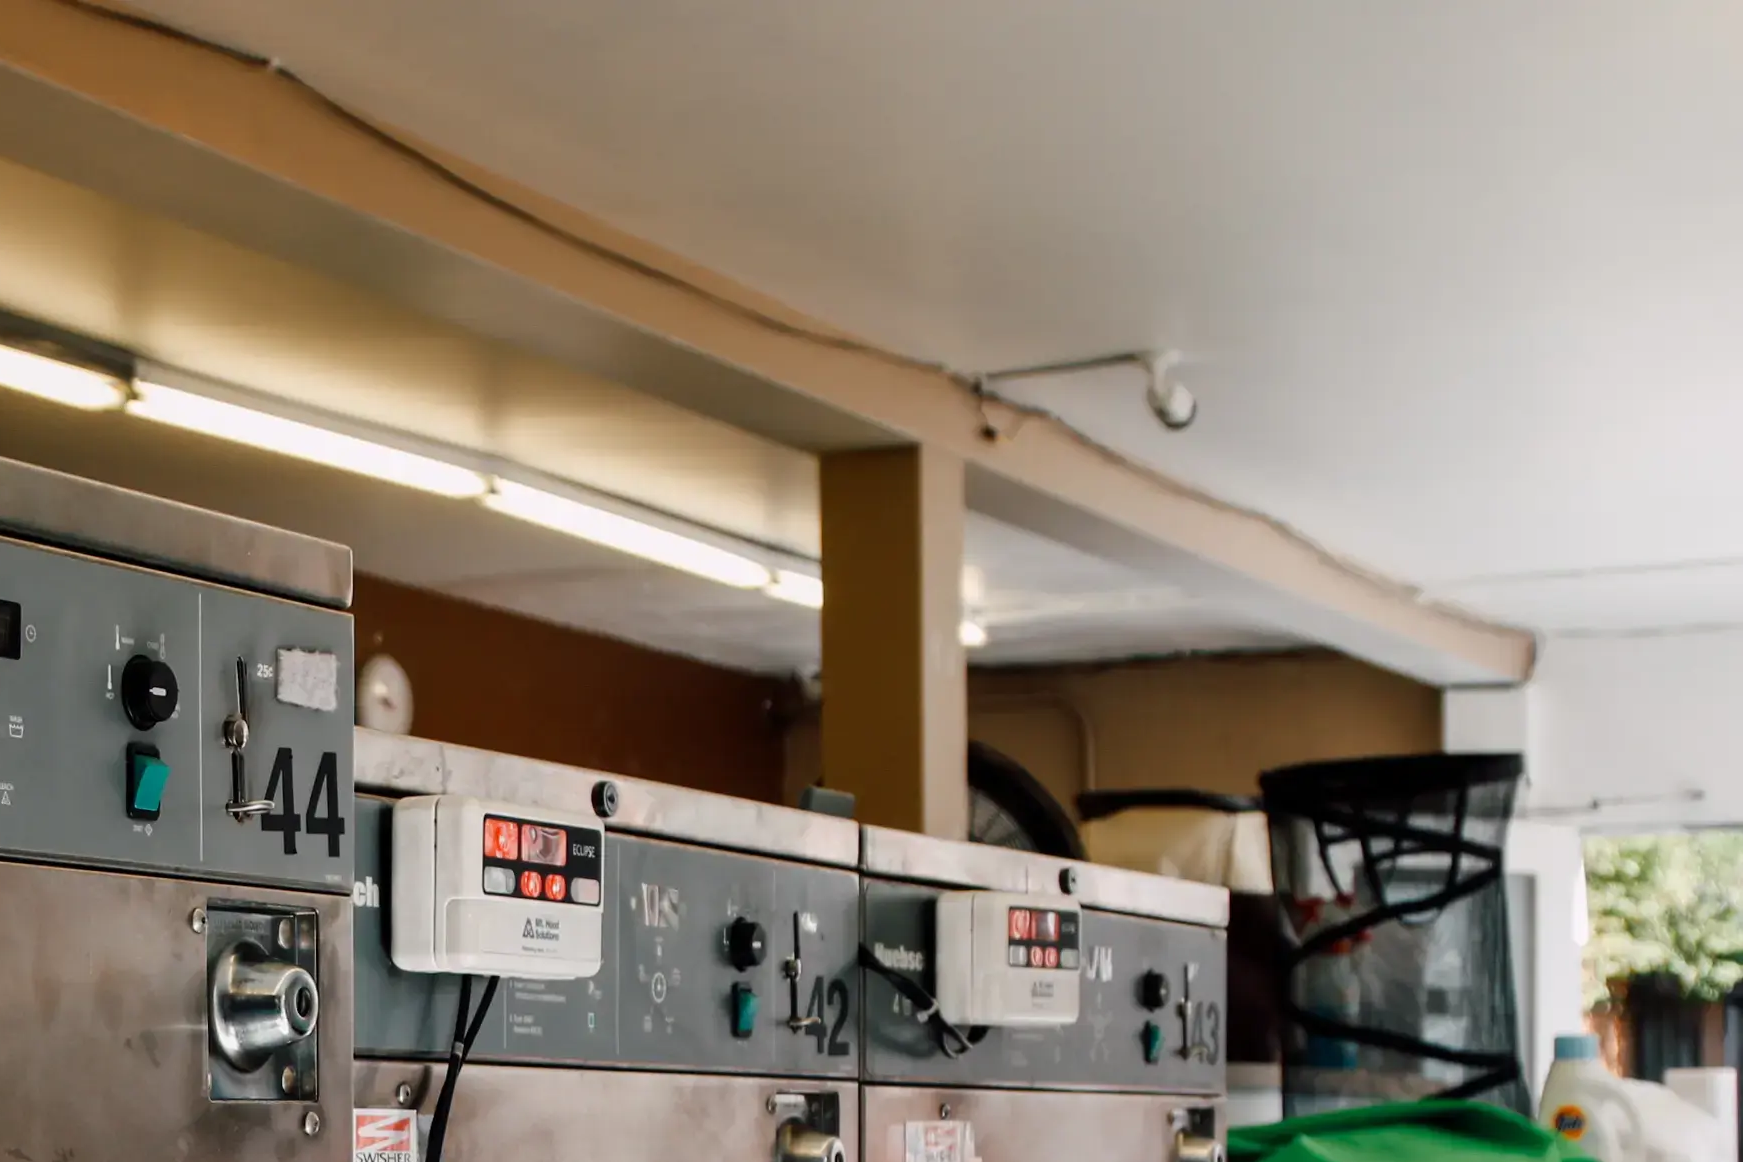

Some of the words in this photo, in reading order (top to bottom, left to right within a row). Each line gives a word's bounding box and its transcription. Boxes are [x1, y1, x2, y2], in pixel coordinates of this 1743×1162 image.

[260, 747, 346, 857] 44
[573, 843, 596, 858] ECLIPSE
[804, 976, 850, 1056] 42
